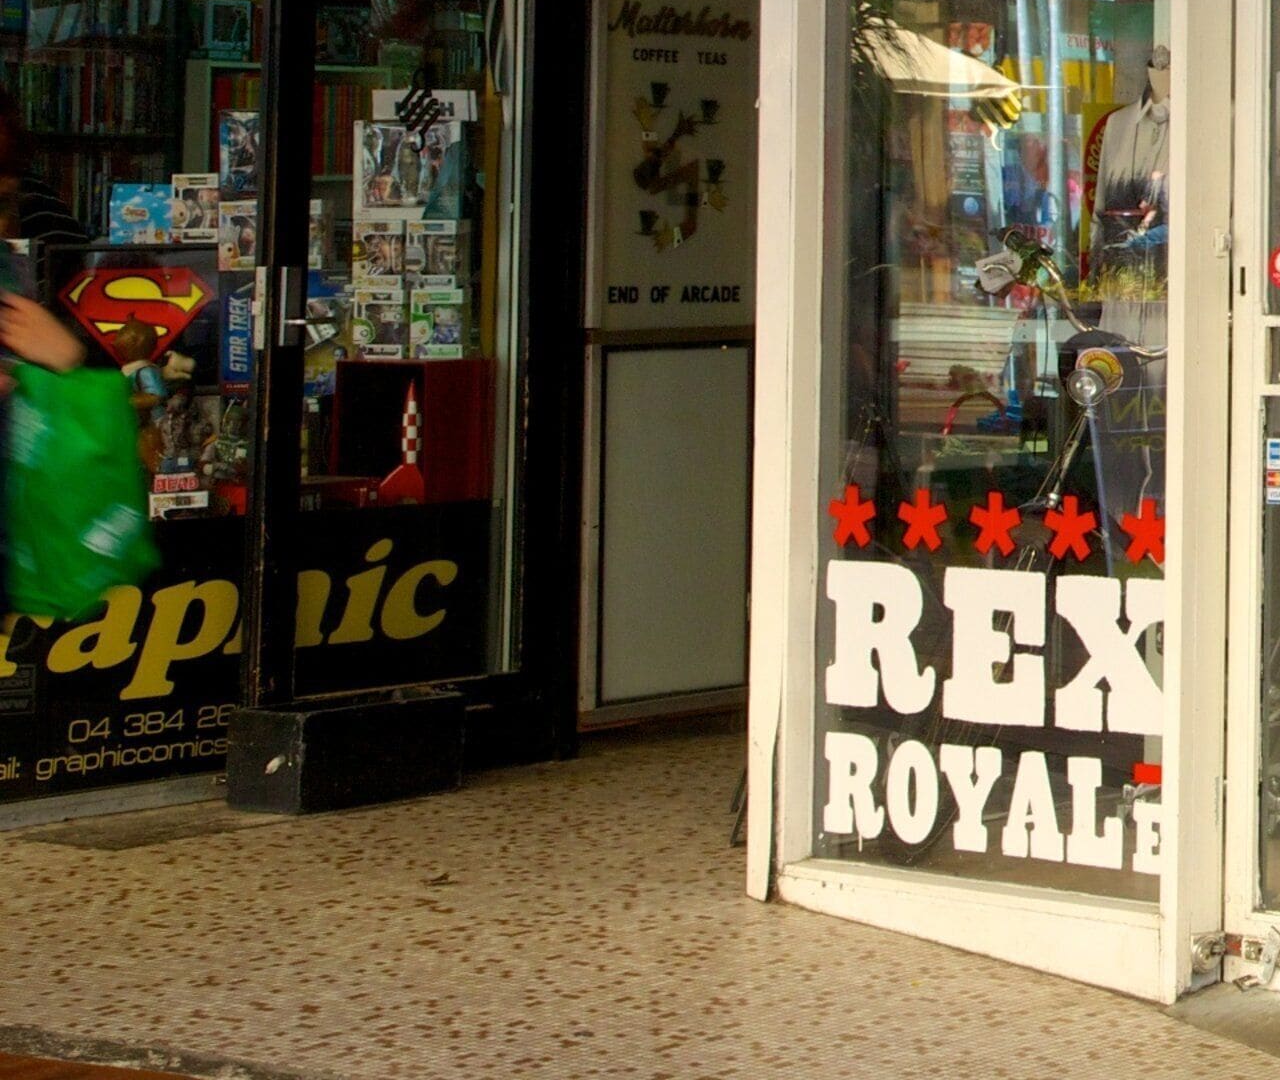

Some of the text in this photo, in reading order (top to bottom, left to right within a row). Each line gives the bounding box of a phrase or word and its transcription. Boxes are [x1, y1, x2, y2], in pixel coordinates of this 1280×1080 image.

[633, 48, 727, 66] COFFEE TEAS
[608, 286, 740, 304] END OF ARCADE
[229, 296, 248, 329] TREK
[826, 560, 1165, 736] REX
[68, 708, 185, 743] 04 384
